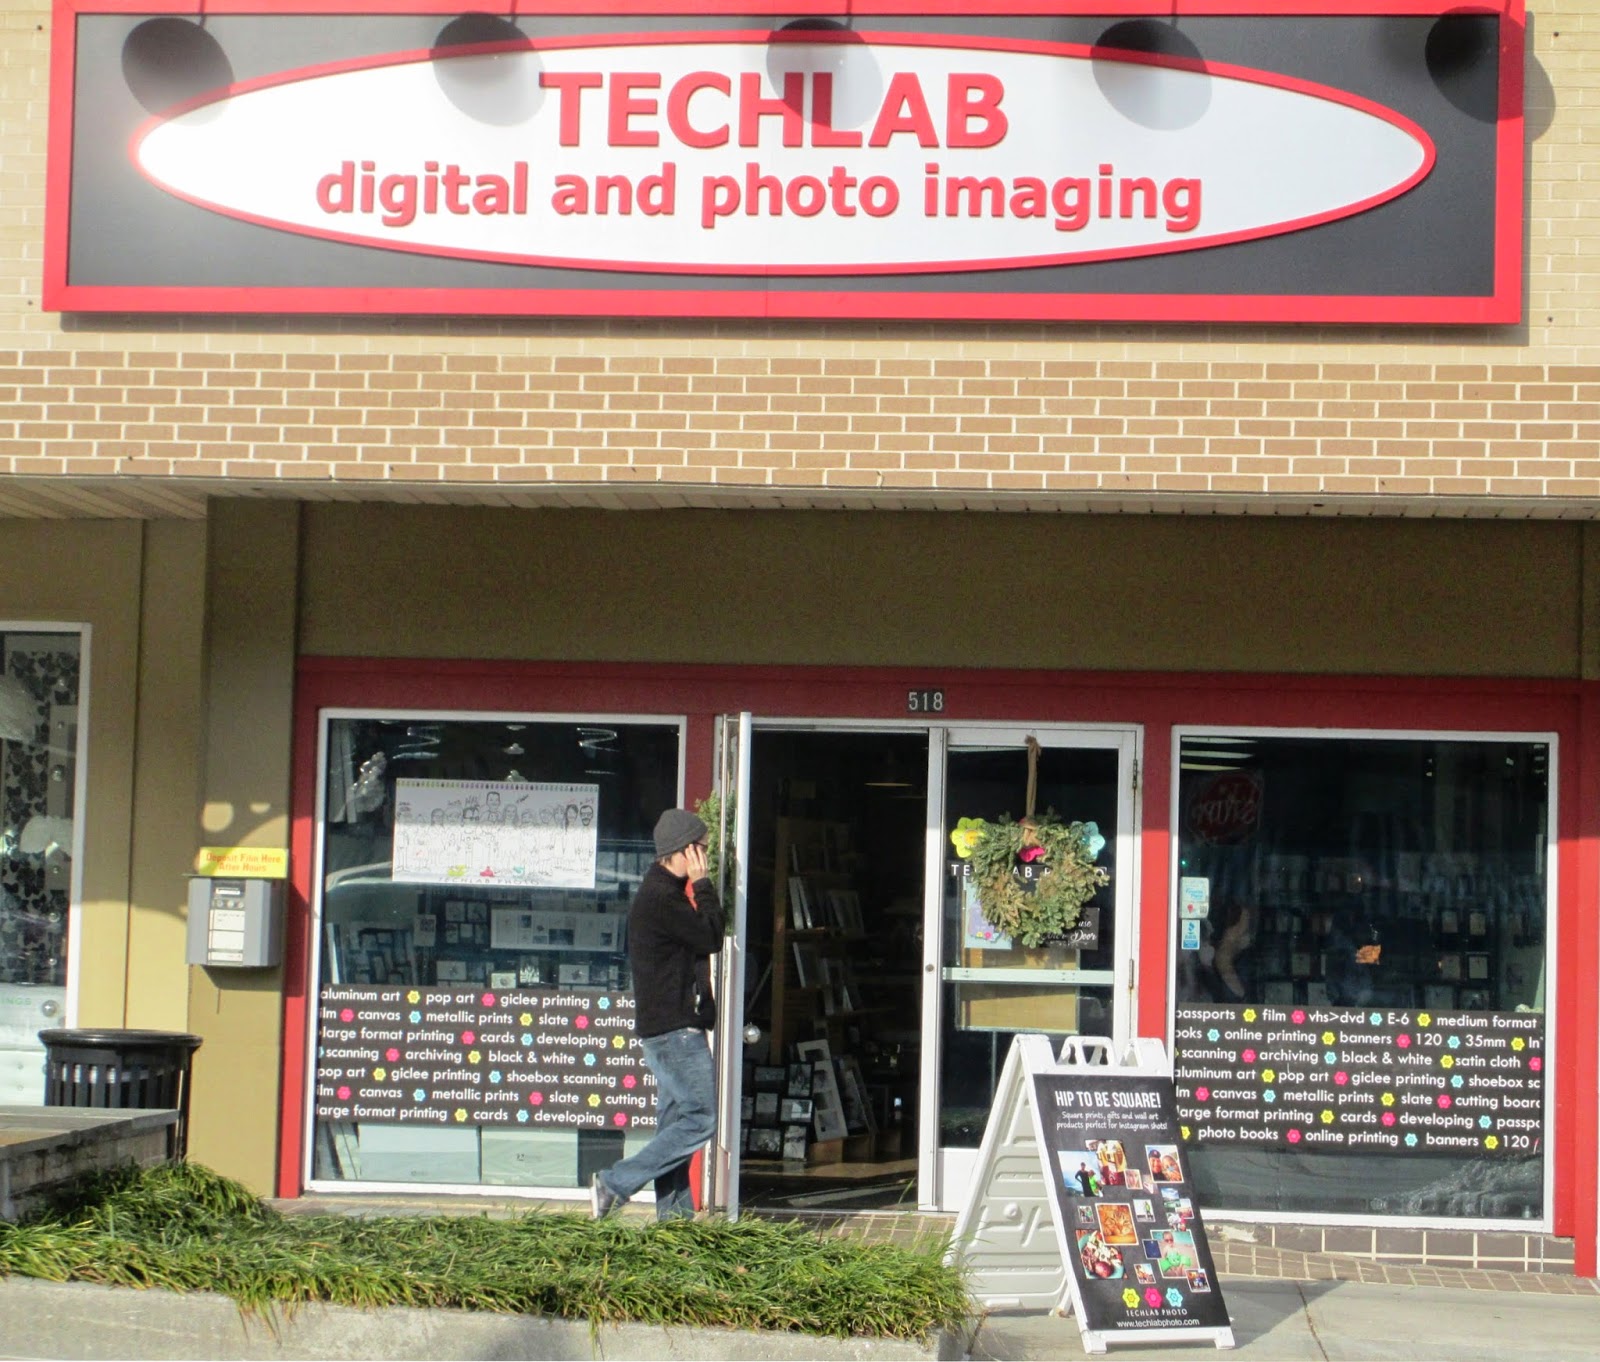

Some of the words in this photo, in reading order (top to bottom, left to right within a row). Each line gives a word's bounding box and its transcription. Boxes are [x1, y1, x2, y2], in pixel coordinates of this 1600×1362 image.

[539, 70, 1009, 149] TECHLAB
[316, 160, 528, 227] digital
[550, 162, 676, 216] and
[701, 162, 899, 228] photo
[924, 163, 1202, 233] imaging
[909, 692, 942, 711] 518
[320, 988, 377, 999] aluminum
[381, 991, 400, 1001] art
[426, 994, 451, 1005] pop
[456, 993, 475, 1003] art
[500, 993, 538, 1007] giclee
[542, 995, 590, 1009] printing
[357, 1011, 400, 1021] canvas
[426, 1011, 475, 1023] metallic
[479, 1013, 513, 1026] prints
[539, 1013, 568, 1025] slate
[594, 1016, 635, 1029] cutting
[1262, 1009, 1286, 1022] film
[1309, 1010, 1365, 1024] vhs>dvd
[1387, 1013, 1409, 1025] E-6
[1437, 1015, 1487, 1027] medium
[1492, 1015, 1537, 1029] format
[323, 1026, 357, 1041] large
[360, 1027, 402, 1040] format
[407, 1030, 454, 1044] printing
[481, 1032, 515, 1043] cards
[536, 1032, 606, 1048] developing
[1224, 1028, 1263, 1040] online
[1267, 1030, 1317, 1045] printing
[1339, 1031, 1392, 1044] banners
[1416, 1033, 1442, 1046] 120
[1465, 1034, 1506, 1047] 35mm
[326, 1047, 379, 1061] scanning
[405, 1048, 462, 1063] archiving
[488, 1051, 523, 1062] black
[527, 1052, 537, 1063] &
[542, 1053, 575, 1064] white
[606, 1055, 635, 1066] satin
[1181, 1048, 1236, 1062] scanning
[1259, 1049, 1318, 1064] archiving
[1341, 1051, 1377, 1063] black
[1382, 1053, 1392, 1064] &
[1398, 1053, 1432, 1065] white
[1455, 1055, 1486, 1067] satin
[1490, 1056, 1521, 1068] cloth
[318, 1068, 342, 1078] pop
[347, 1068, 365, 1077] art
[391, 1067, 428, 1082] giclee
[433, 1069, 480, 1083] printing
[507, 1070, 558, 1083] shoebox
[563, 1073, 616, 1087] scanning
[1175, 1066, 1232, 1079] aluminum
[1236, 1069, 1256, 1080] art
[1279, 1071, 1304, 1083] pop
[1309, 1072, 1329, 1082] art
[1352, 1072, 1391, 1084] giclee
[1396, 1073, 1446, 1088] printing
[1468, 1074, 1523, 1088] shoebox
[359, 1088, 402, 1098] canvas
[432, 1088, 481, 1100] metallic
[485, 1090, 519, 1103] prints
[549, 1091, 579, 1103] slate
[605, 1094, 646, 1108] cutting
[1055, 1091, 1074, 1106] HIP
[1076, 1091, 1093, 1107] TO
[1094, 1092, 1110, 1107] BE
[1112, 1092, 1161, 1108] SQUARE!
[1212, 1089, 1257, 1099] canvas
[1283, 1090, 1334, 1102] metallic
[1339, 1092, 1374, 1103] prints
[1401, 1092, 1432, 1105] slate
[1455, 1096, 1498, 1110] cutting
[353, 1105, 395, 1117] format
[400, 1107, 447, 1121] printing
[473, 1110, 508, 1120] cards
[534, 1110, 605, 1124] developing
[1061, 1111, 1083, 1120] Square
[1215, 1106, 1259, 1119] format
[1264, 1109, 1313, 1124] printing
[1340, 1111, 1377, 1123] cards
[1400, 1112, 1473, 1128] developing
[1057, 1120, 1083, 1130] products
[1086, 1120, 1107, 1130] perfect
[1108, 1120, 1117, 1129] for
[1198, 1125, 1236, 1140] photo
[1240, 1127, 1278, 1140] books
[1305, 1129, 1344, 1142] online
[1348, 1131, 1398, 1147] printing
[1426, 1132, 1479, 1146] banners
[1503, 1135, 1529, 1148] 120
[1116, 1318, 1200, 1327] www.techlabphoto.com
